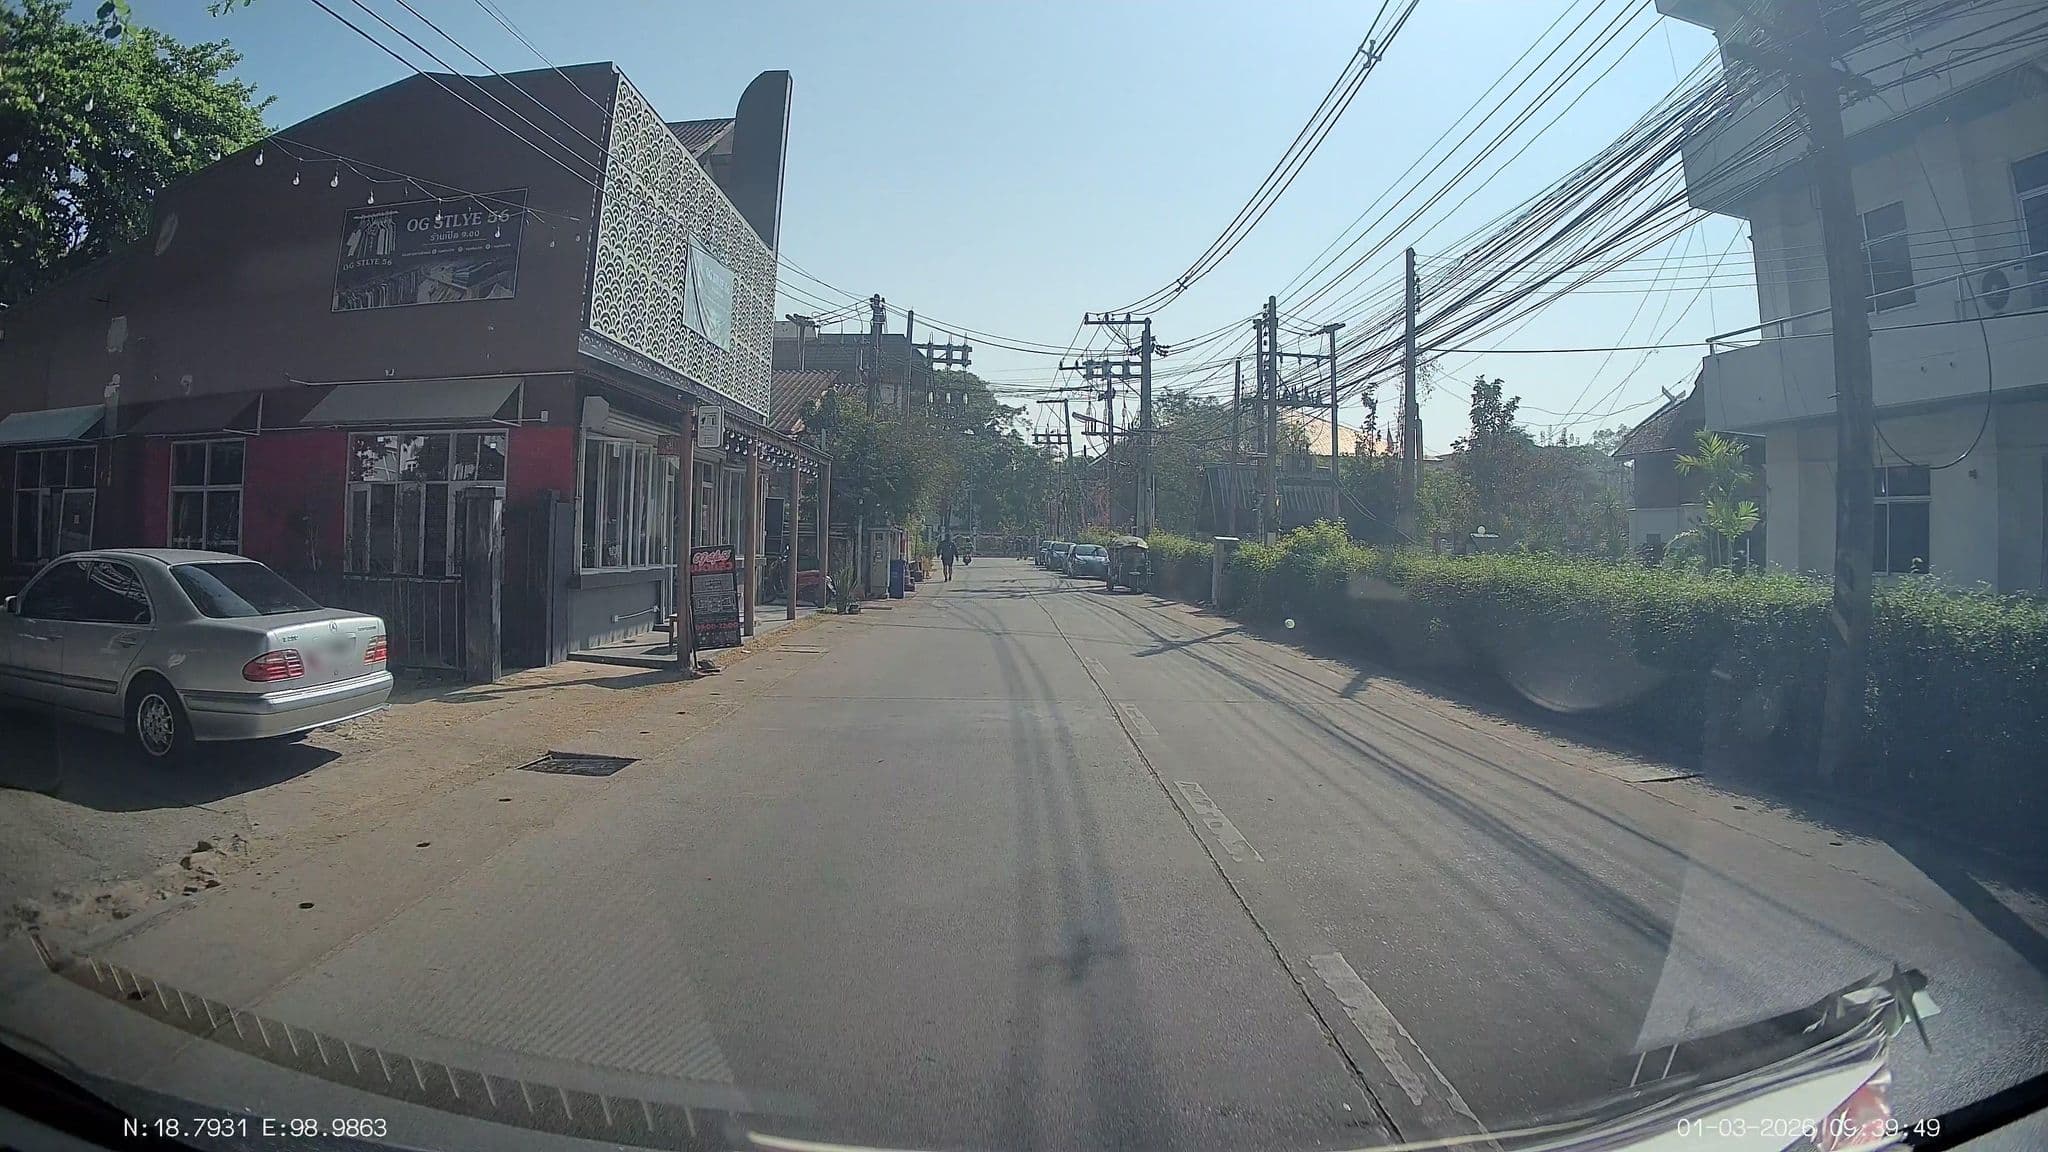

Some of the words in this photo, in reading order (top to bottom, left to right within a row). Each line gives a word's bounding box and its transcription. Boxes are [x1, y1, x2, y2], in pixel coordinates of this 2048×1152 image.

[406, 217, 430, 232] OG
[433, 211, 483, 229] STLYE
[487, 208, 510, 224] 56
[343, 261, 355, 271] OG
[356, 258, 381, 267] STLYE
[382, 257, 392, 266] 56
